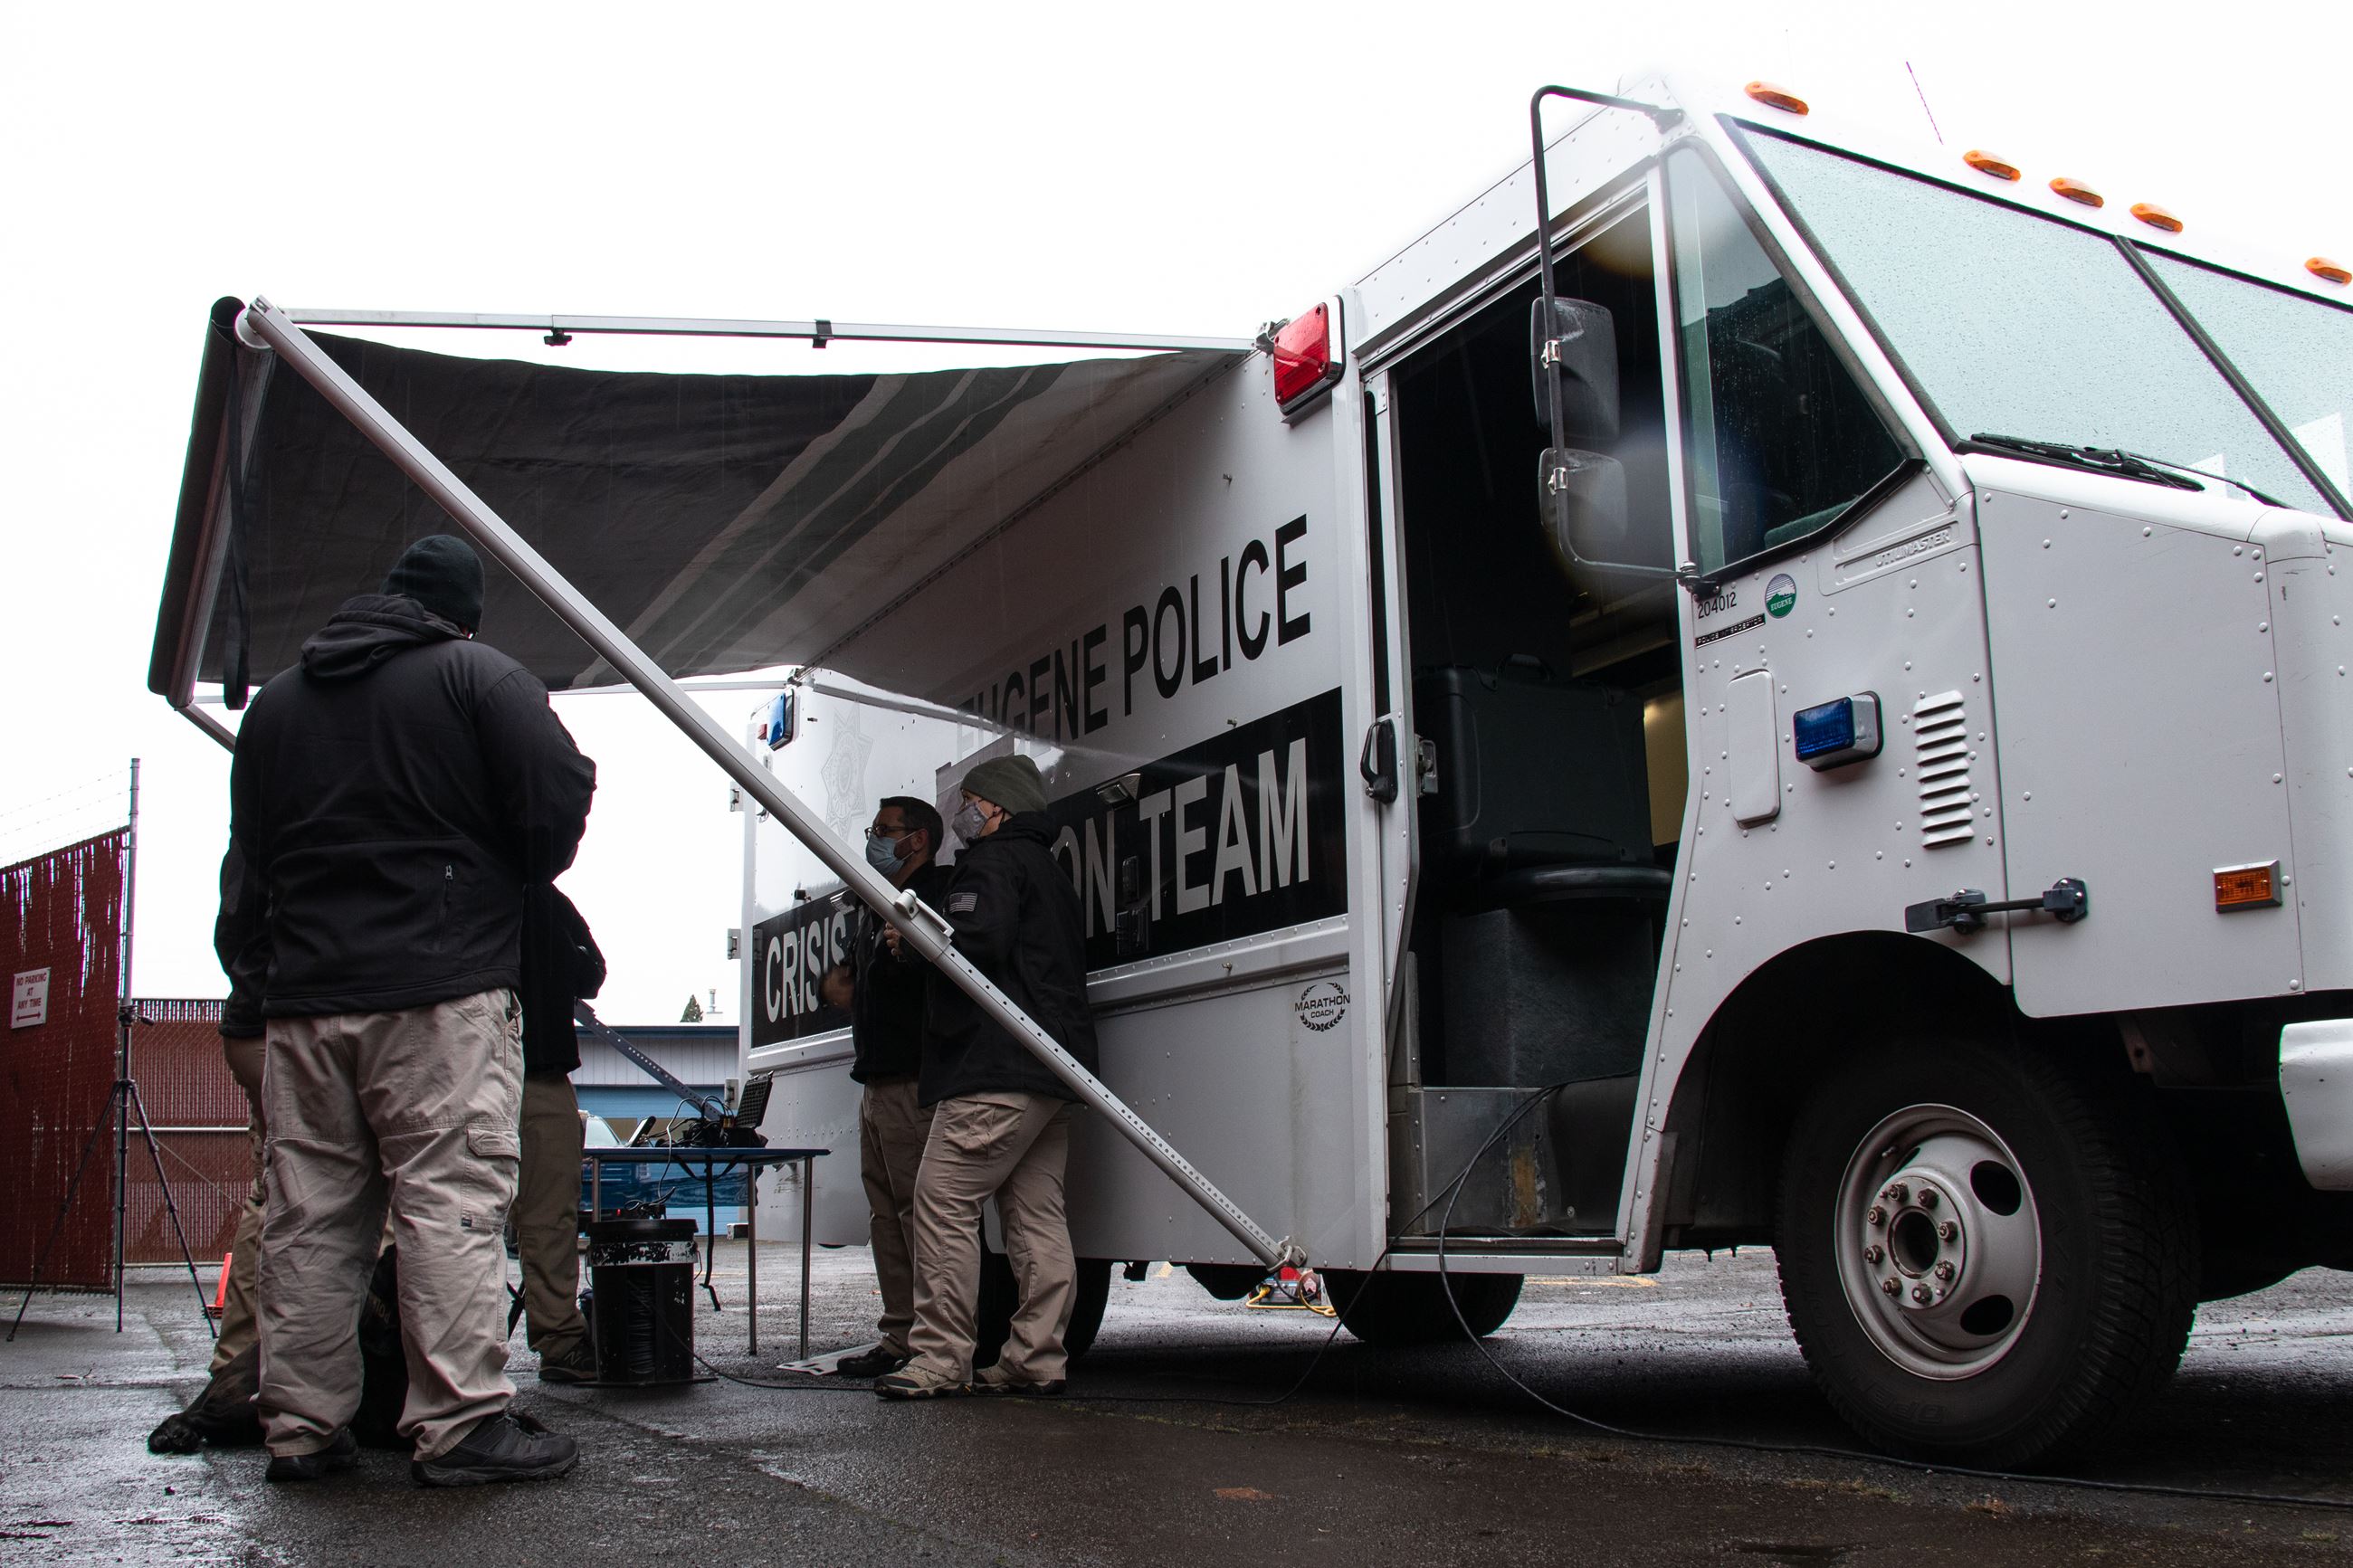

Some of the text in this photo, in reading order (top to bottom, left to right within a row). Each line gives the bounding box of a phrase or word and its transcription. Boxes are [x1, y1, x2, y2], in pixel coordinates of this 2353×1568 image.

[1697, 592, 1737, 619] 204012
[1770, 596, 1793, 612] EUGENE
[1123, 514, 1310, 717] POLICE
[766, 910, 846, 1023] CRISIS
[1139, 737, 1309, 922] TEAM
[16, 972, 47, 986] NO PARKING
[27, 987, 33, 996] AT
[17, 997, 42, 1011] ANY TIME
[1294, 994, 1350, 1012] MARATHON
[1310, 1009, 1334, 1019] COACH
